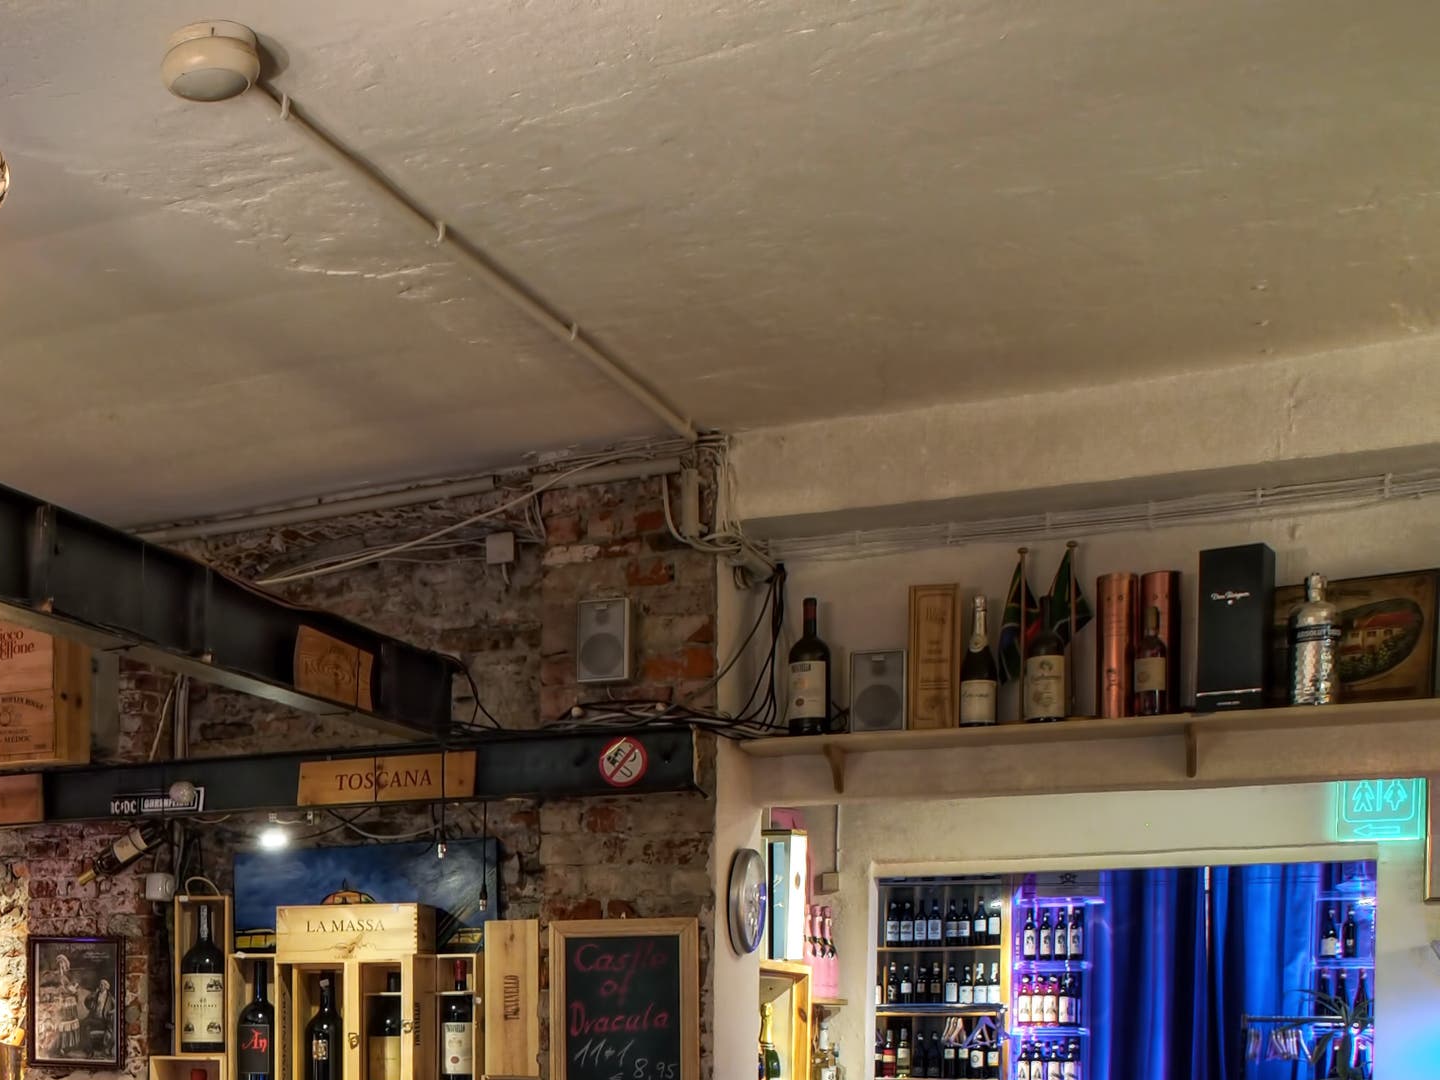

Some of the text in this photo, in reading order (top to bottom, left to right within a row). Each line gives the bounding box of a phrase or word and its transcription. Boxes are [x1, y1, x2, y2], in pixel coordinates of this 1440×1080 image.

[335, 769, 432, 791] TOSCANA
[307, 919, 385, 933] LA MASSA
[599, 971, 633, 1005] of
[570, 1001, 671, 1037] Dracula
